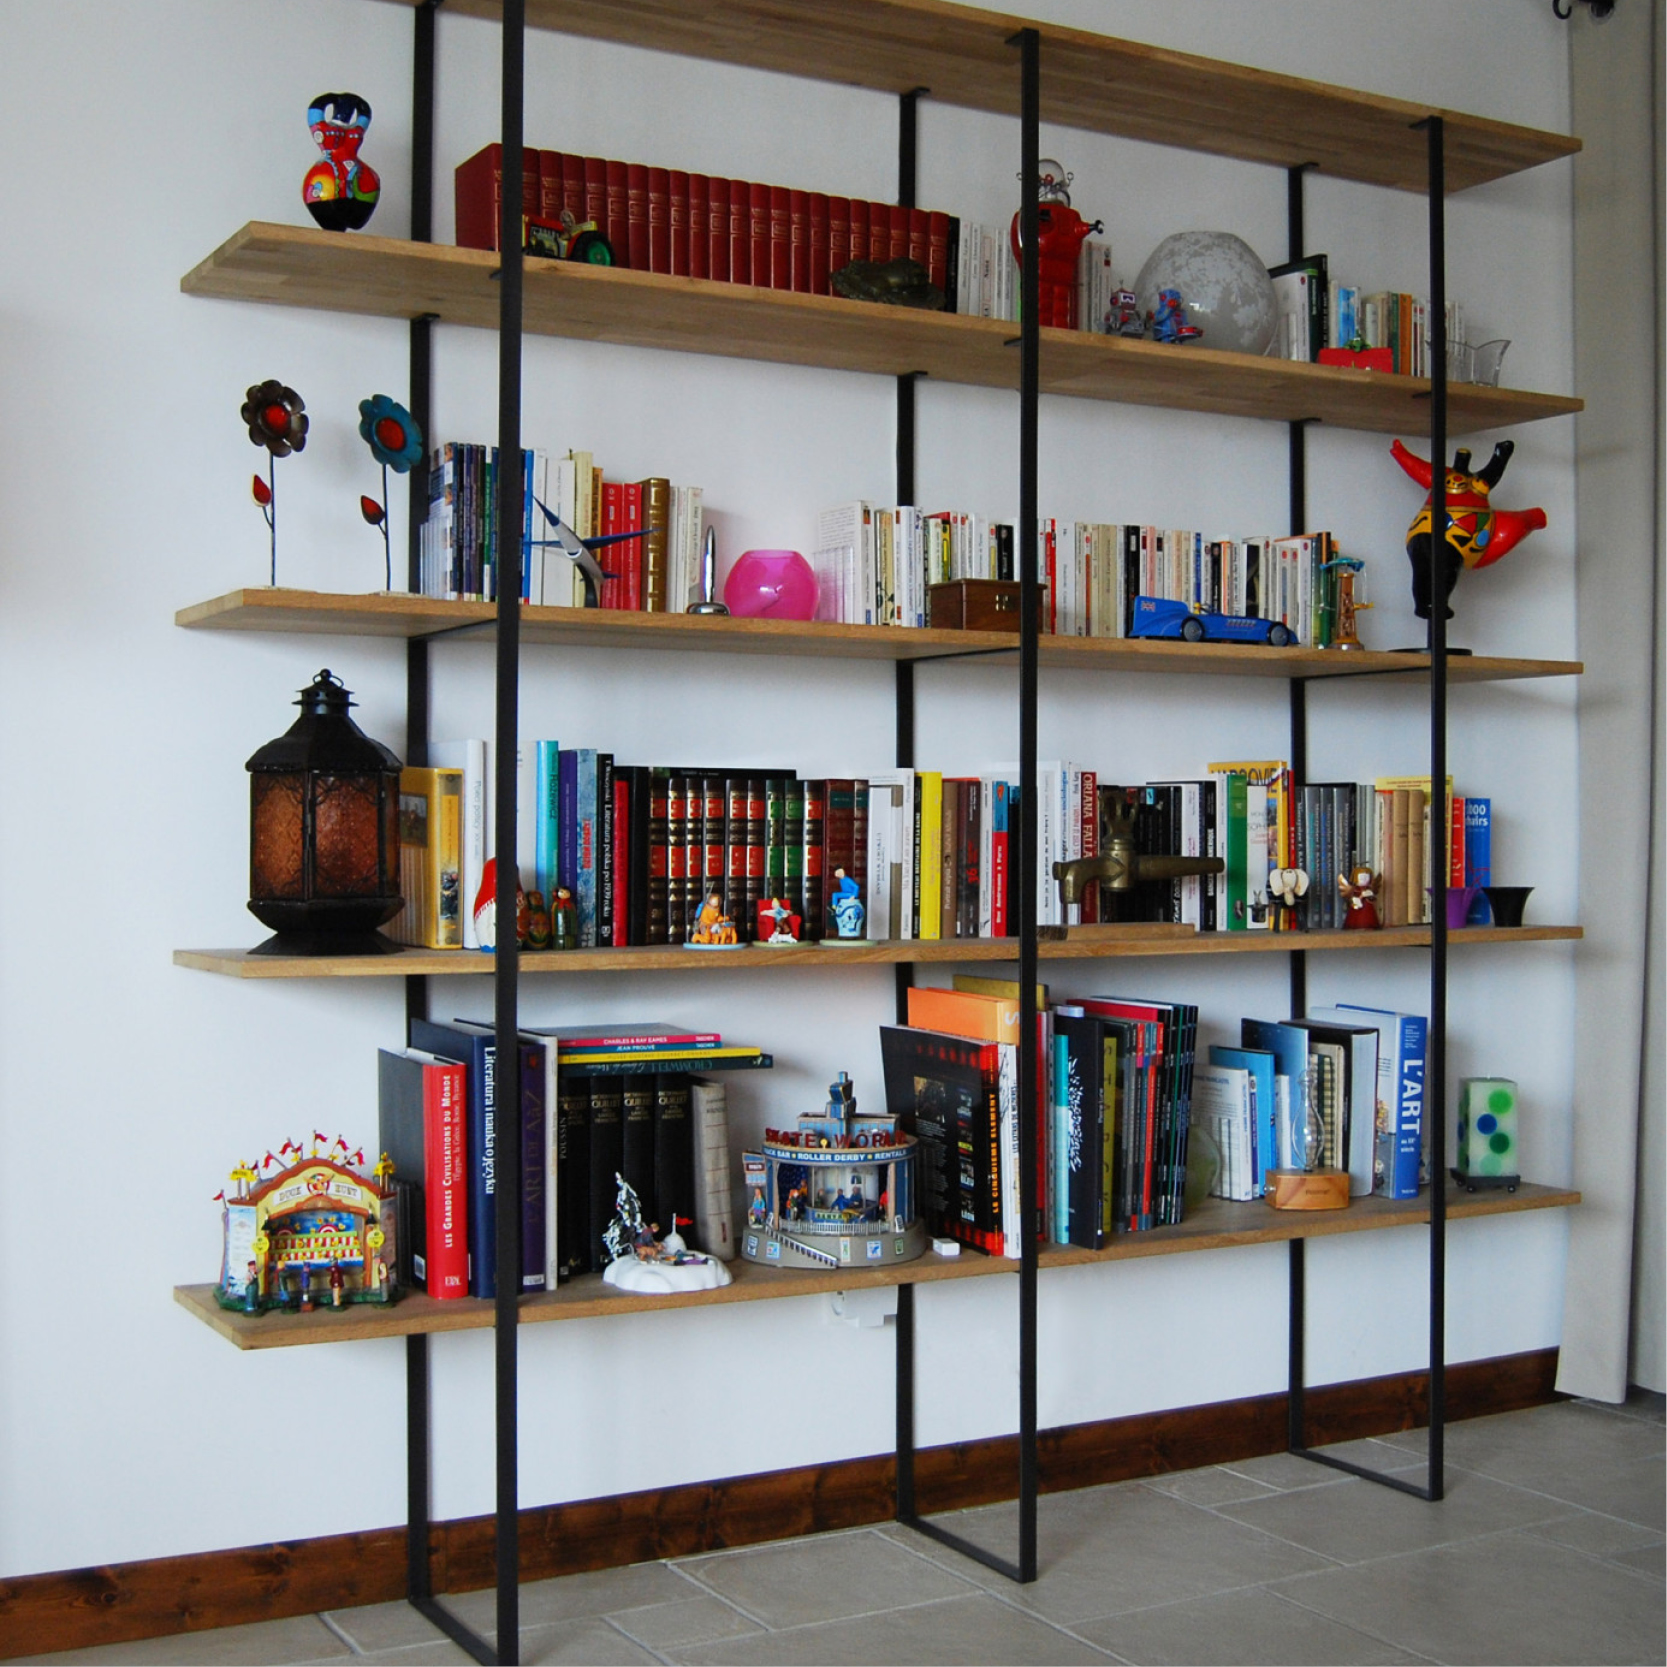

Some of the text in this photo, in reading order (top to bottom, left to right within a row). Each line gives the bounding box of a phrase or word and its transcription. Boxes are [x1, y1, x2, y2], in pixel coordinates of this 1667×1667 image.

[604, 804, 613, 843] Literatura
[1083, 773, 1093, 859] ORIANA FALLA
[603, 844, 611, 869] polska
[648, 1036, 667, 1044] EAMES
[484, 1046, 496, 1105] Literatura
[989, 1093, 997, 1138] ELEMENT
[1401, 1059, 1424, 1135] L'ART
[484, 1112, 496, 1148] nauka
[559, 1117, 567, 1160] POUSSIN
[440, 1075, 453, 1248] LES GRANDES CIVILISATIONS DU MONDE
[797, 1152, 831, 1162] ROLLER
[834, 1153, 866, 1162] DERBY
[992, 1202, 999, 1214] LE
